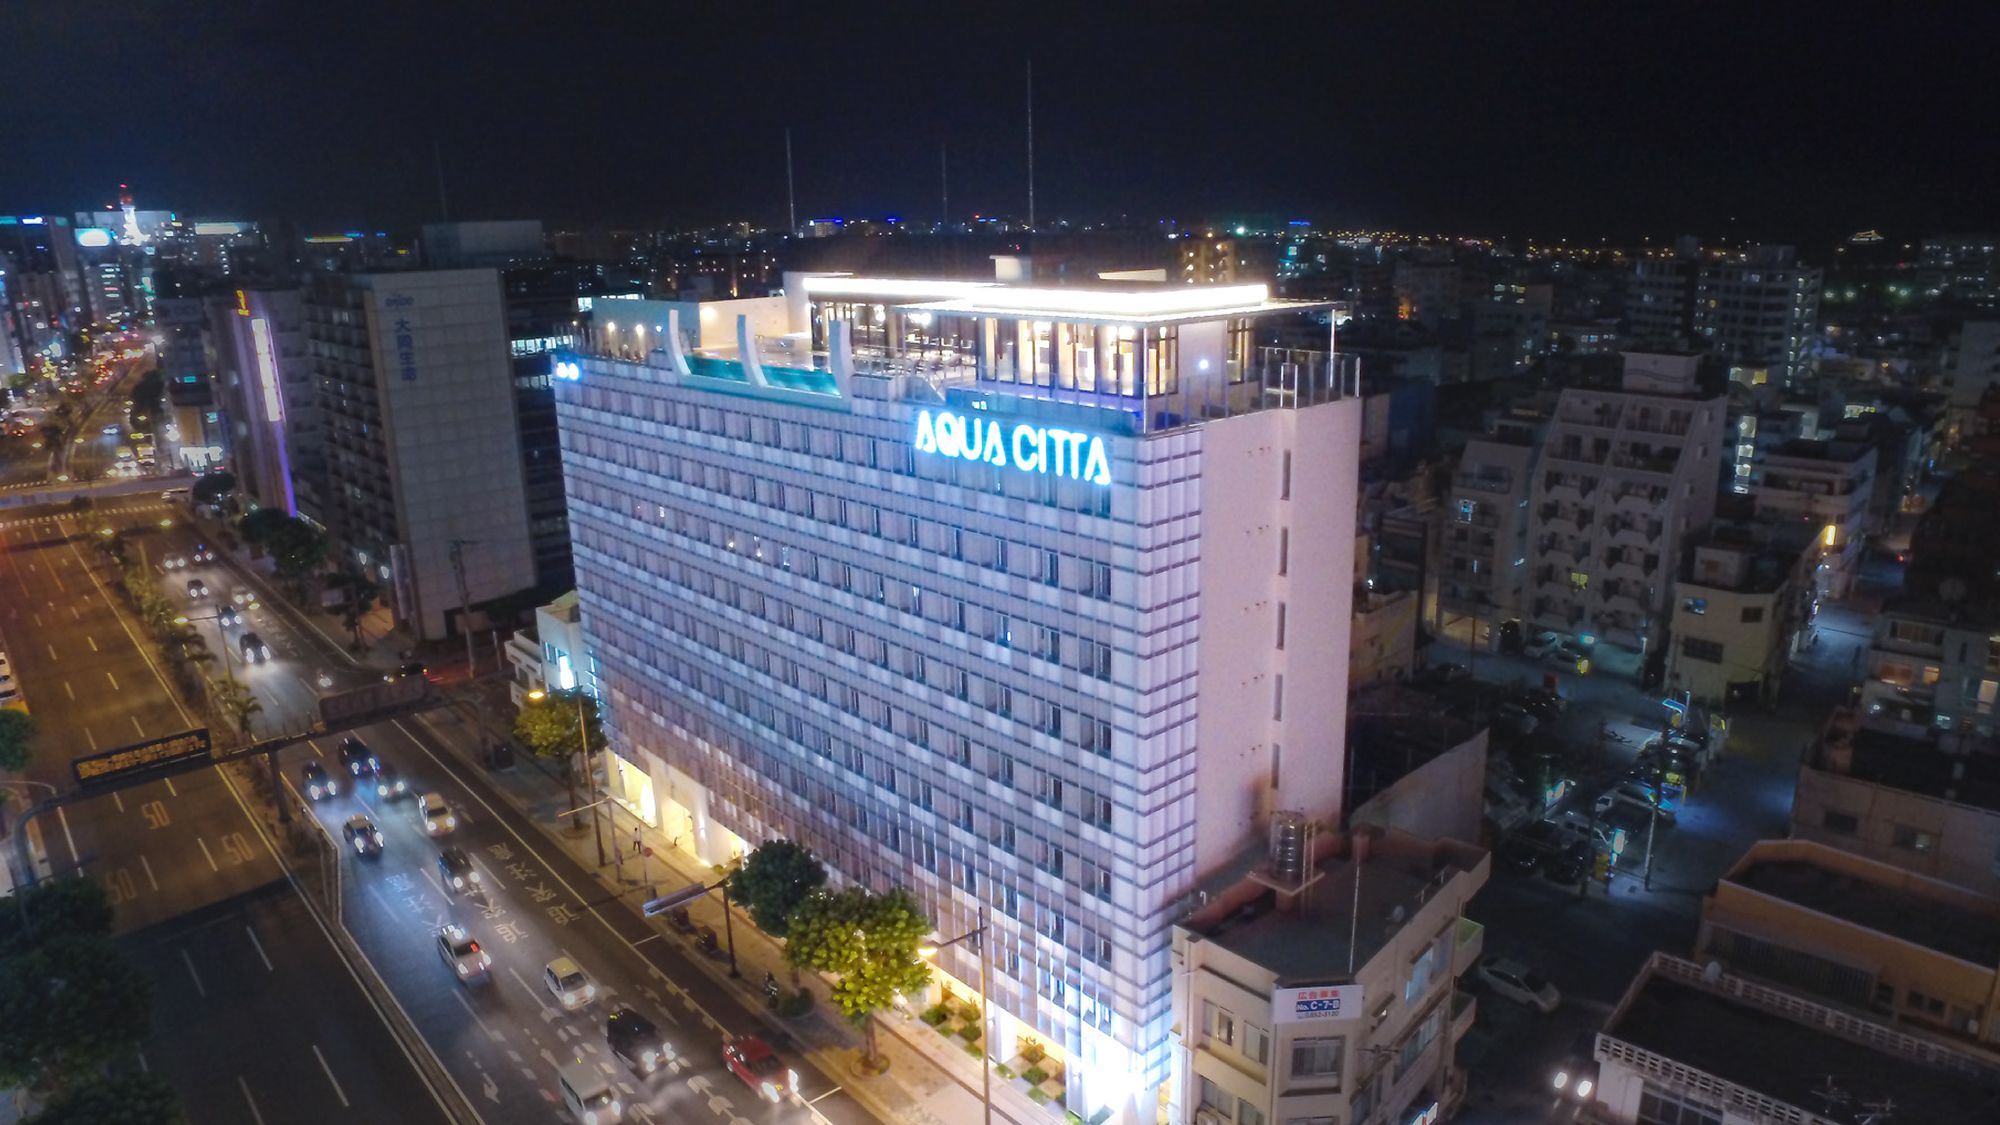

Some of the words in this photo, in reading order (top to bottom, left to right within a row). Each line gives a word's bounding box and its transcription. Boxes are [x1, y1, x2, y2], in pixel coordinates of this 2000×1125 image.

[915, 410, 1007, 466] AQUA
[1012, 424, 1111, 486] CITTA
[141, 800, 170, 829] 50
[221, 832, 255, 865] 50
[105, 868, 136, 905] 50
